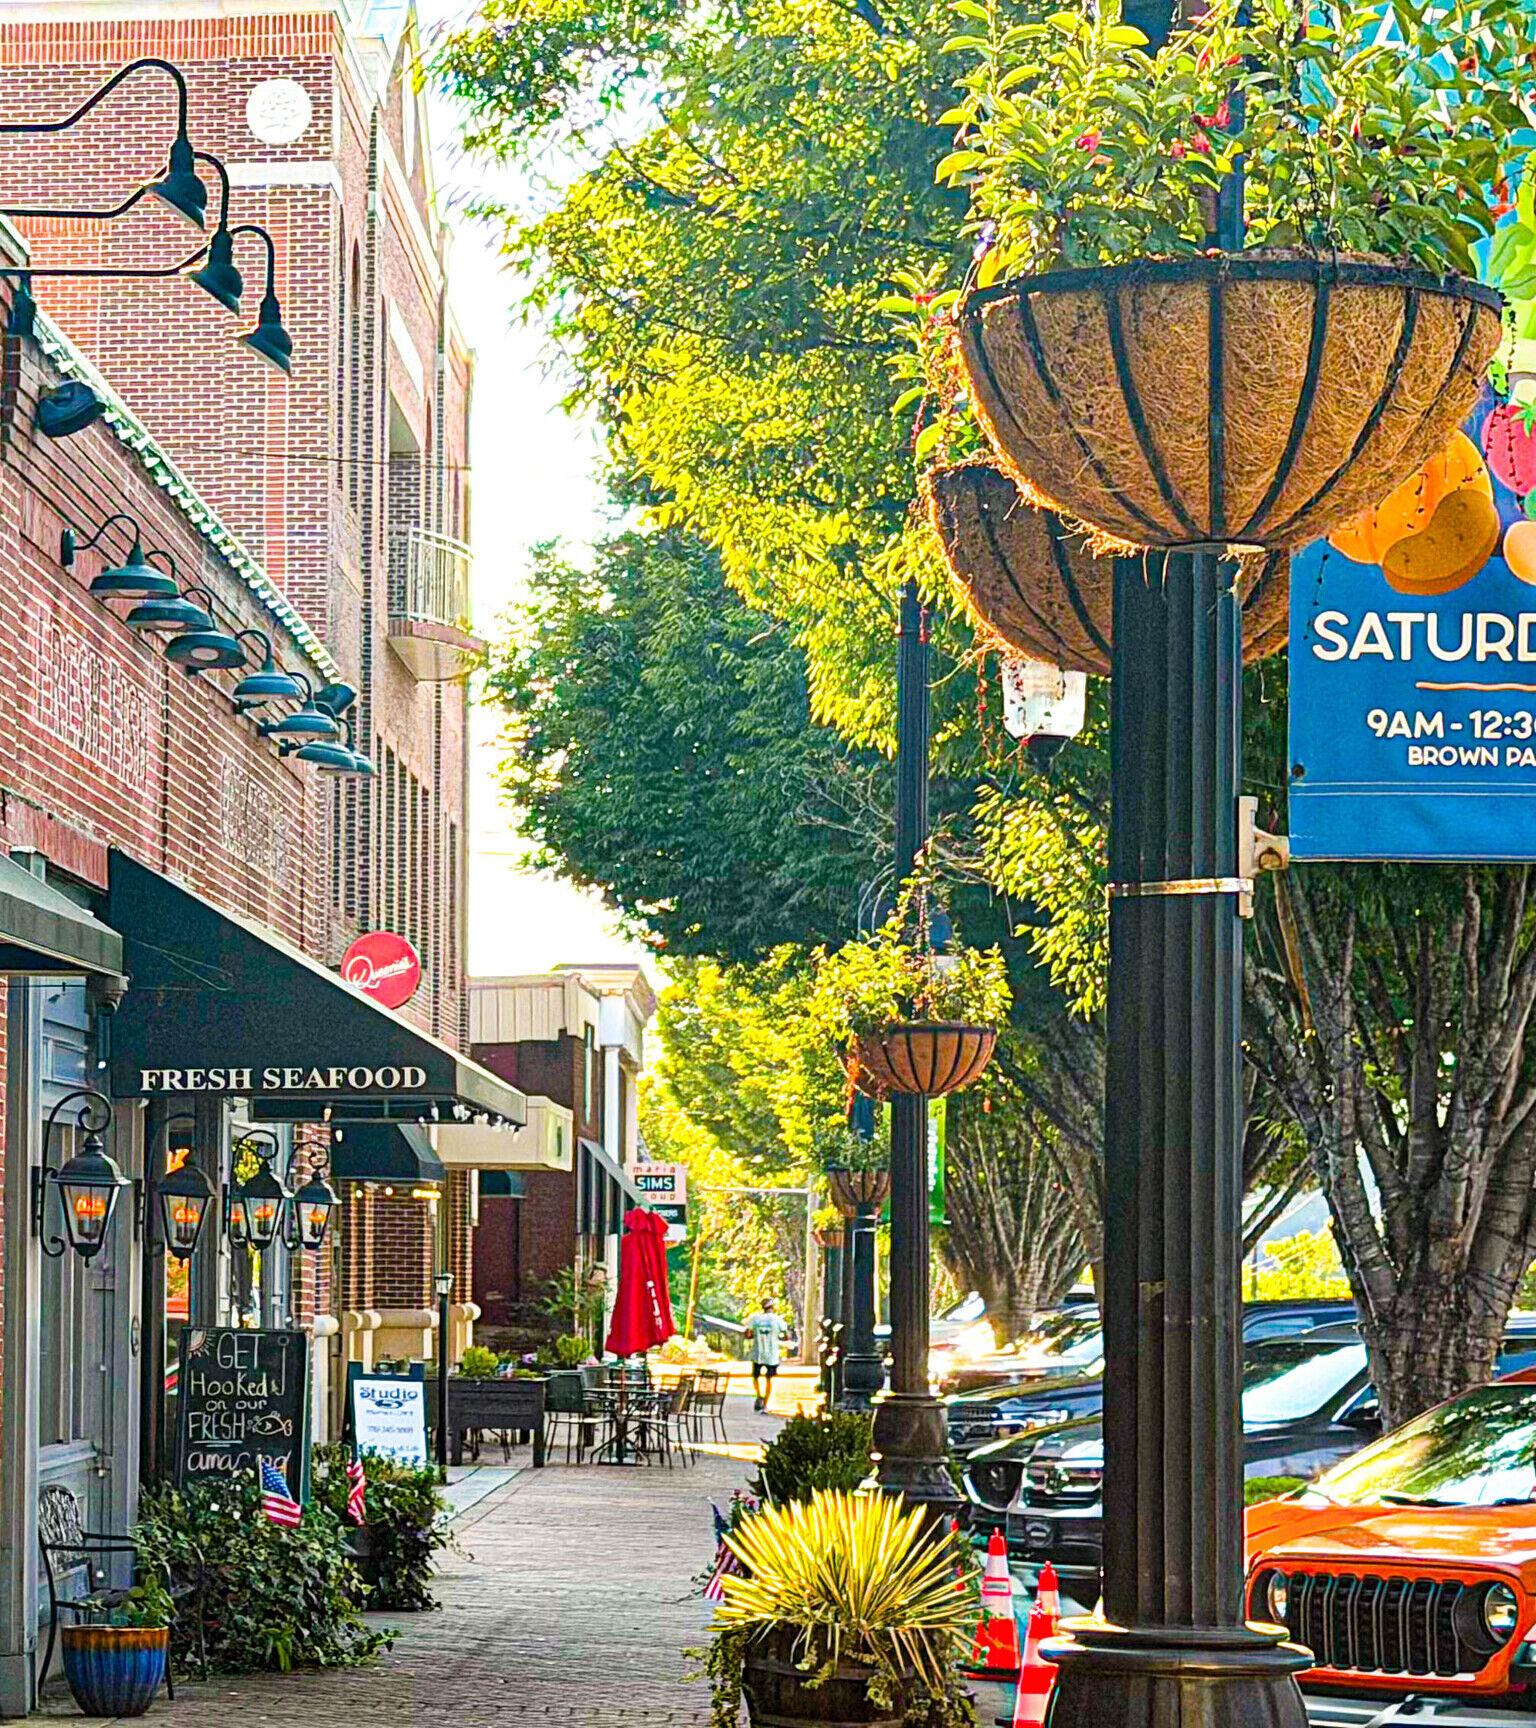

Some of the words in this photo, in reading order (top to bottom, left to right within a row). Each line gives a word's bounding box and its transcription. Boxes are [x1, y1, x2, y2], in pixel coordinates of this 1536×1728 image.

[1367, 709, 1444, 739] 9AM
[1469, 710, 1536, 739] 12:3
[1408, 746, 1499, 767] BROWN
[140, 1068, 253, 1091] FRESH
[263, 1066, 427, 1090] SEAFOOD
[636, 1177, 673, 1190] SIMS
[217, 1332, 266, 1369] GET
[359, 1387, 418, 1399] Studio
[206, 1400, 227, 1411] on
[235, 1400, 267, 1410] our
[188, 1412, 245, 1439] FRESH
